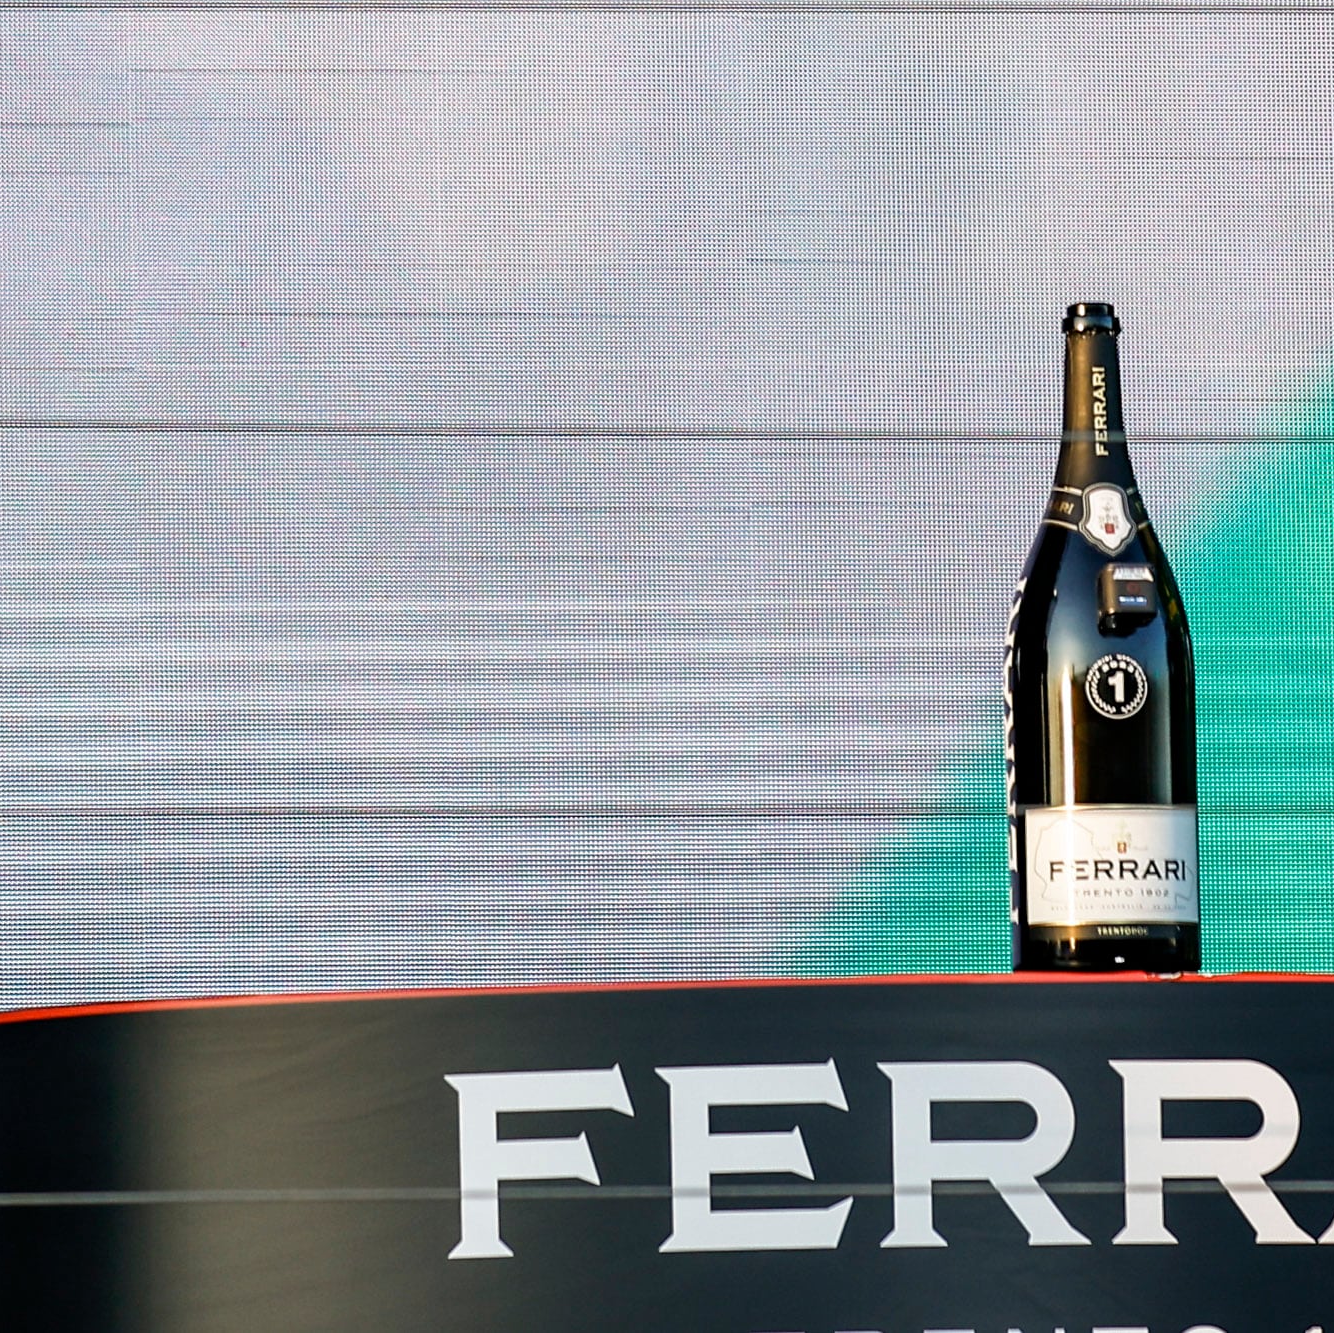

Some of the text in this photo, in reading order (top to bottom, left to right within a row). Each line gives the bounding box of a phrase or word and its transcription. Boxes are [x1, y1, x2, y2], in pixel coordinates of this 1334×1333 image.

[1091, 366, 1109, 456] FERRARI
[1108, 670, 1125, 703] 1
[1049, 859, 1187, 882] FERRARI
